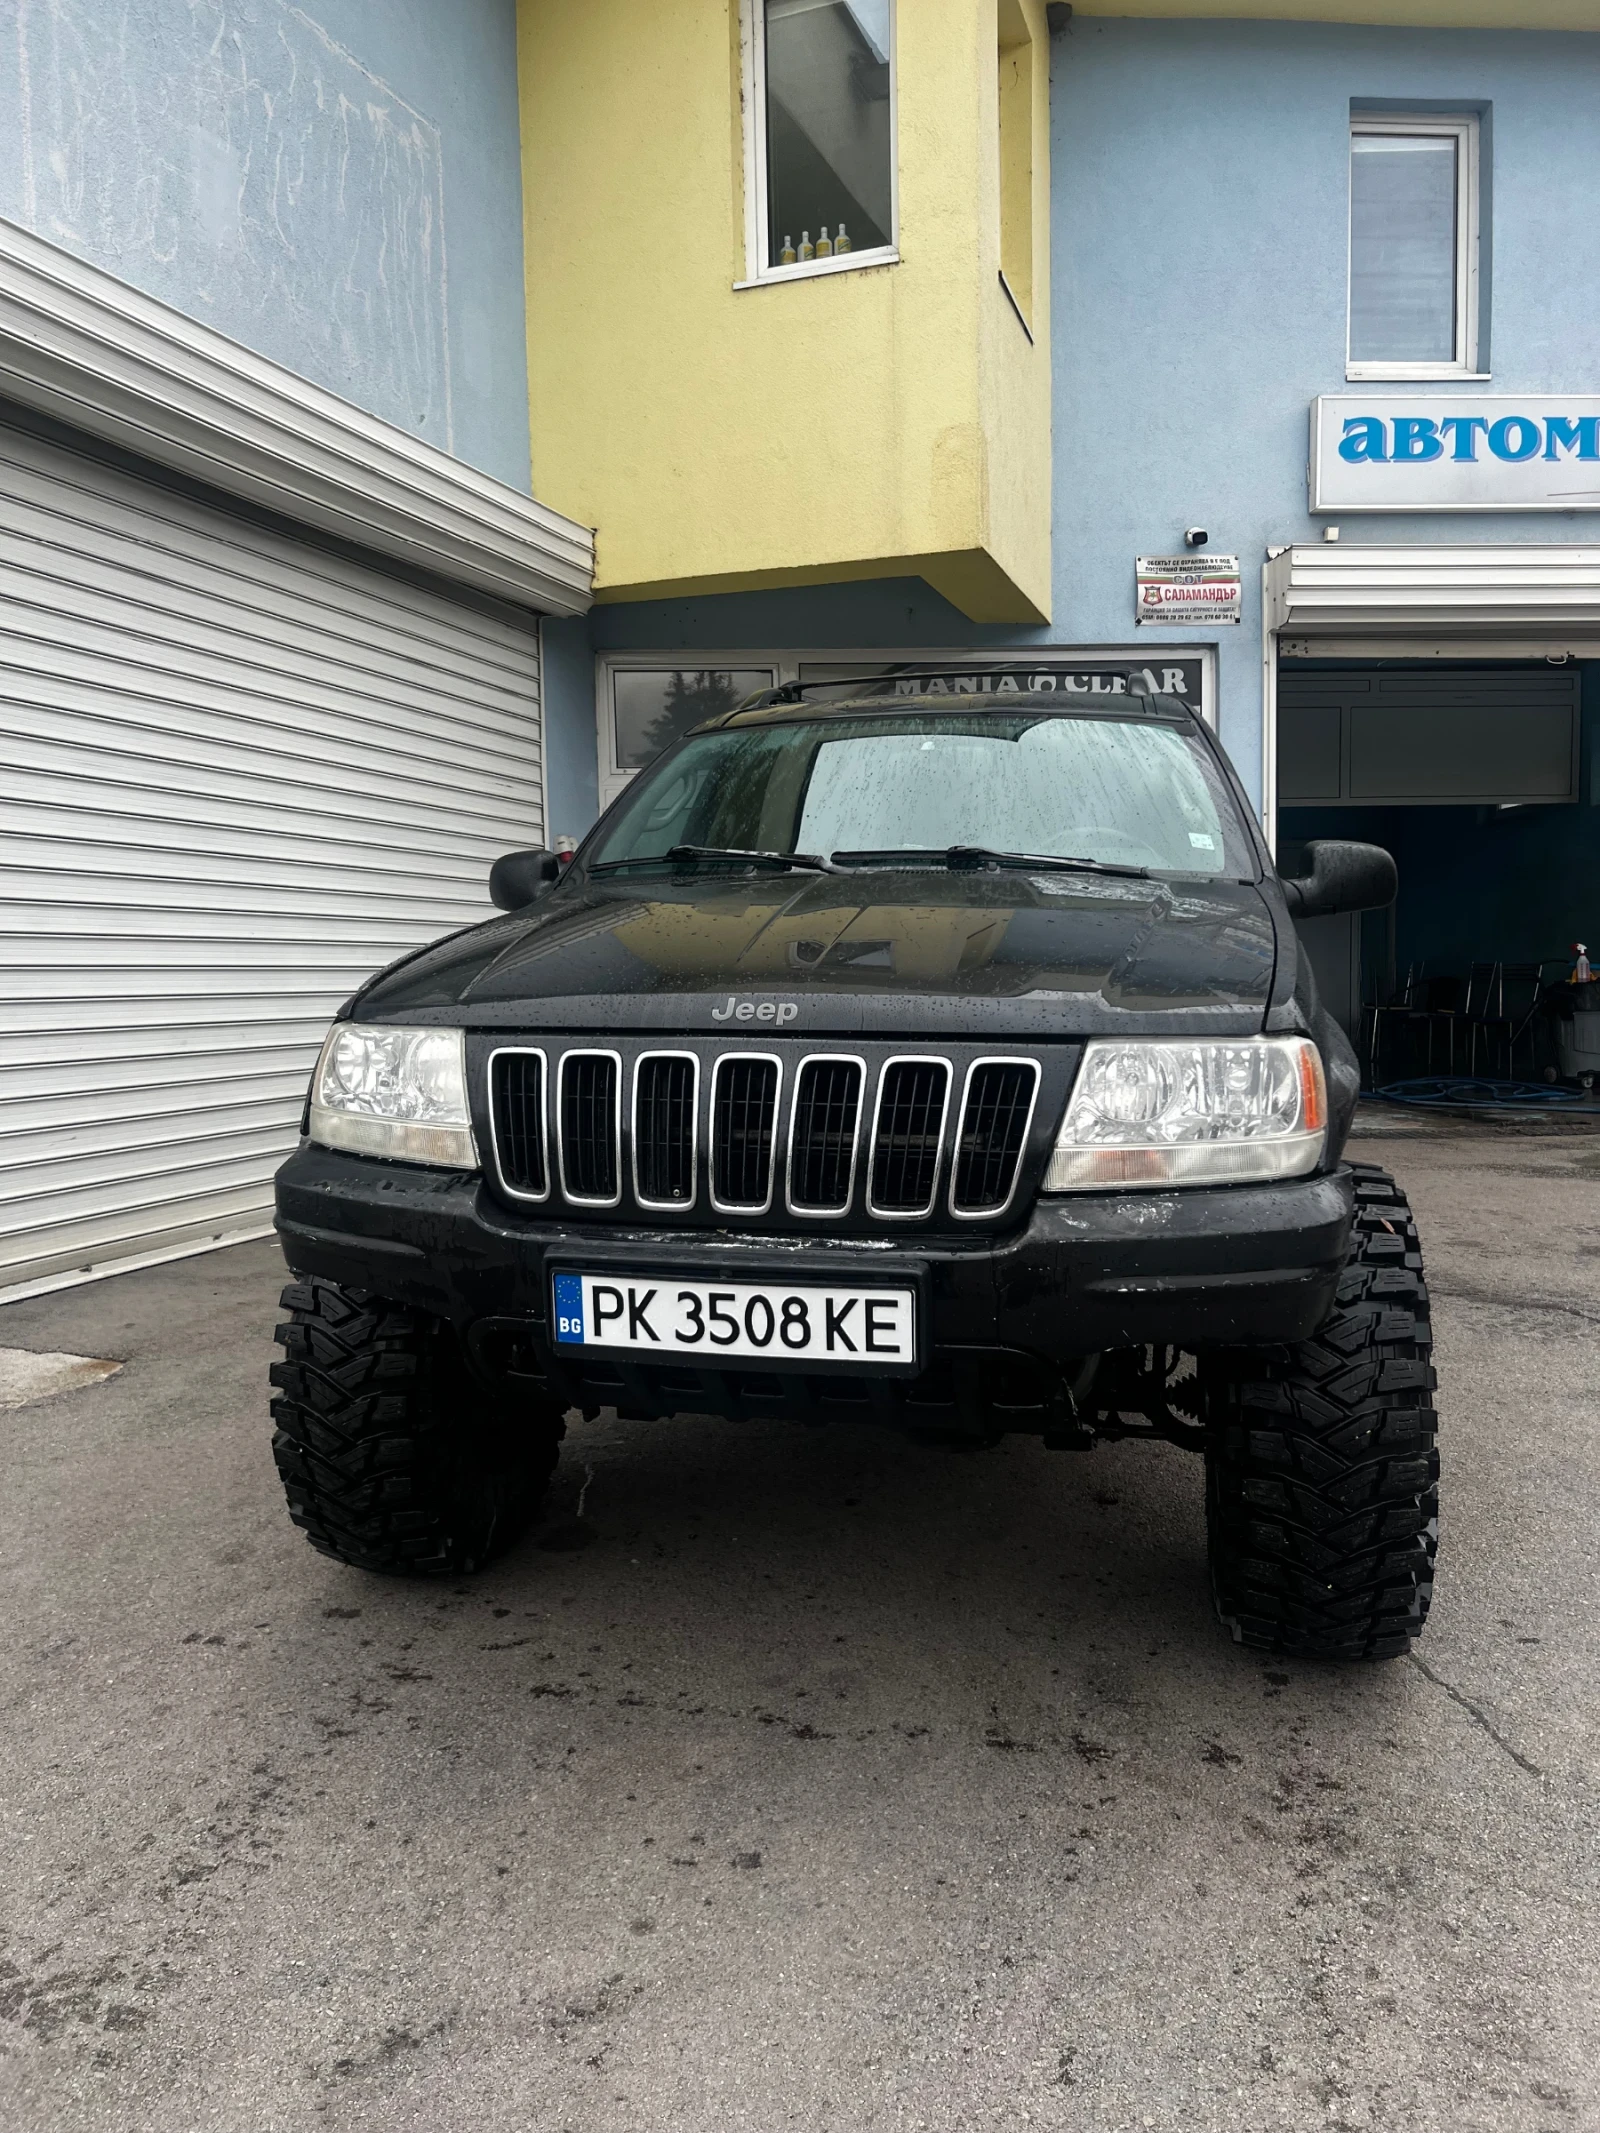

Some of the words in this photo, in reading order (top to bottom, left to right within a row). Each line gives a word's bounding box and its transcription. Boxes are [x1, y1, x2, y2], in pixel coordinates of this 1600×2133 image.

[1173, 575, 1203, 584] СОТ
[1165, 588, 1236, 602] САЛАМАНДЪР
[895, 675, 1019, 696] MANIA
[711, 997, 798, 1026] Jeep
[559, 1317, 582, 1334] BG
[592, 1285, 662, 1341] PK
[675, 1291, 811, 1349] 3508
[825, 1297, 900, 1353] KE
